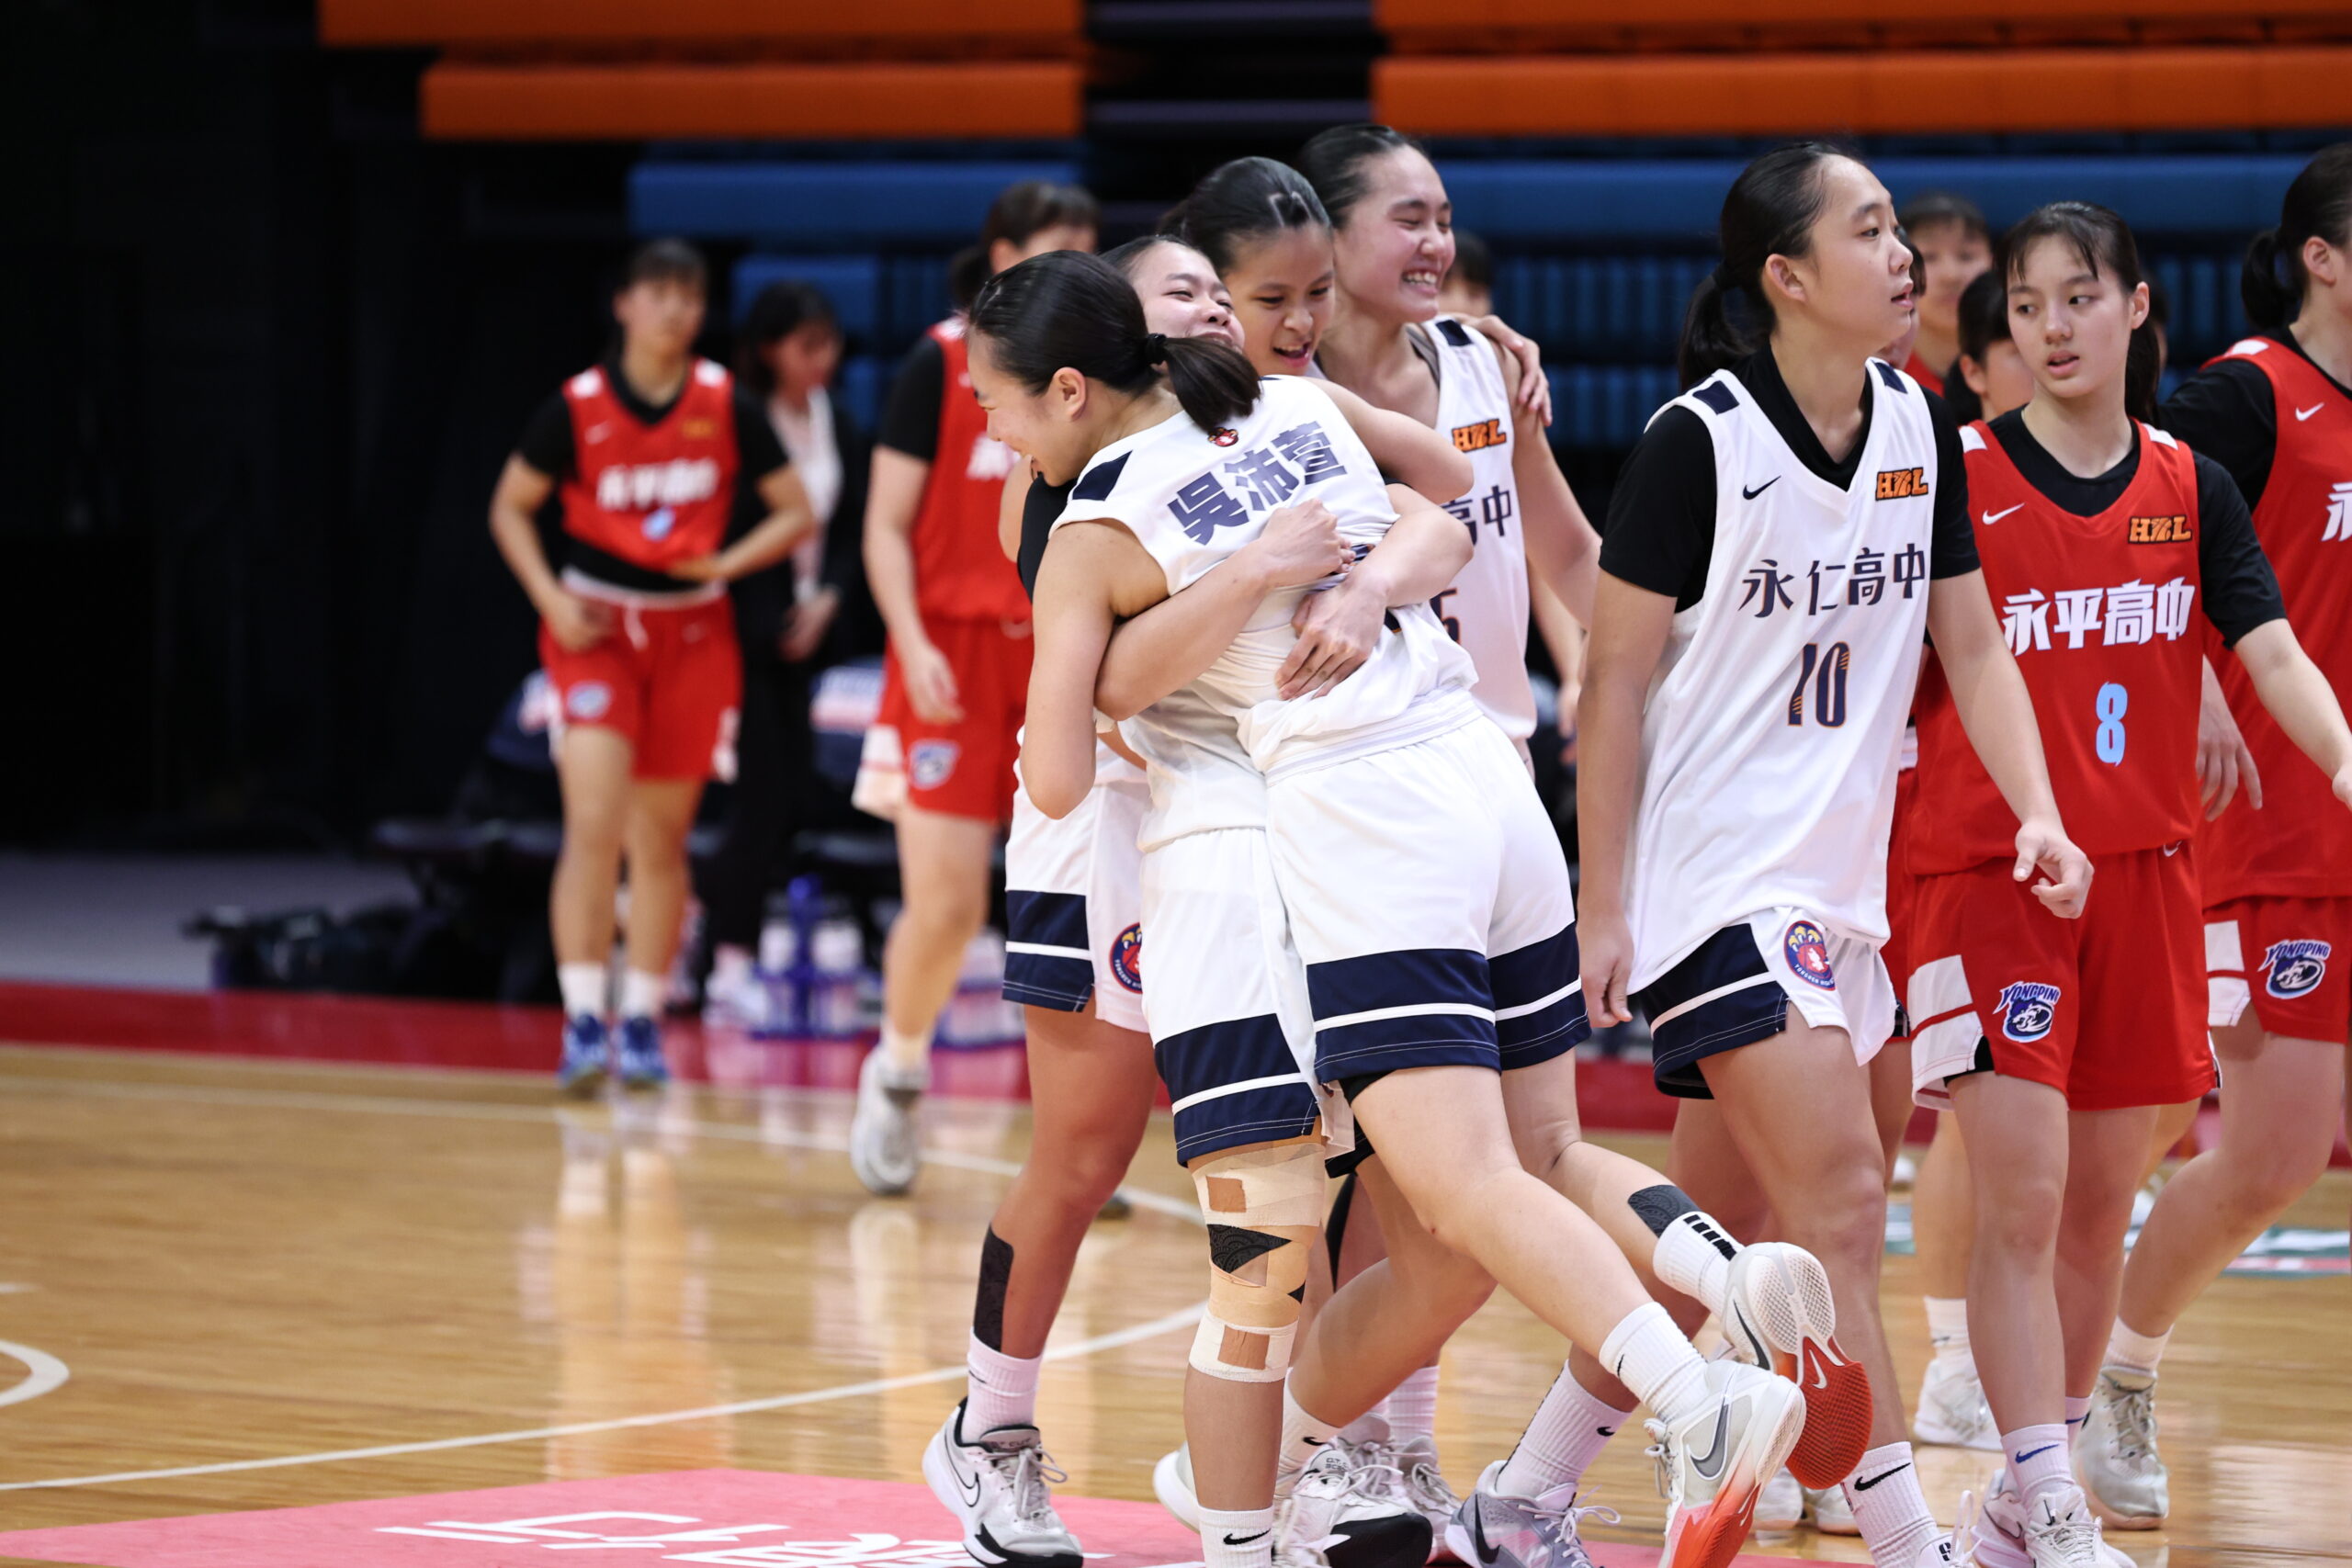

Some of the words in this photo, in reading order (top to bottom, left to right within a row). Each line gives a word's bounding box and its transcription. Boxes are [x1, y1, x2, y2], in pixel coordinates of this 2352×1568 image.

[1167, 421, 1348, 546] 吳沛萱
[1875, 467, 1928, 501] HBL
[2128, 514, 2193, 544] HBL
[1738, 543, 1925, 618] 永仁高中
[2001, 576, 2196, 657] 永平高中
[1788, 641, 1850, 728] 10
[2096, 682, 2128, 767] 8
